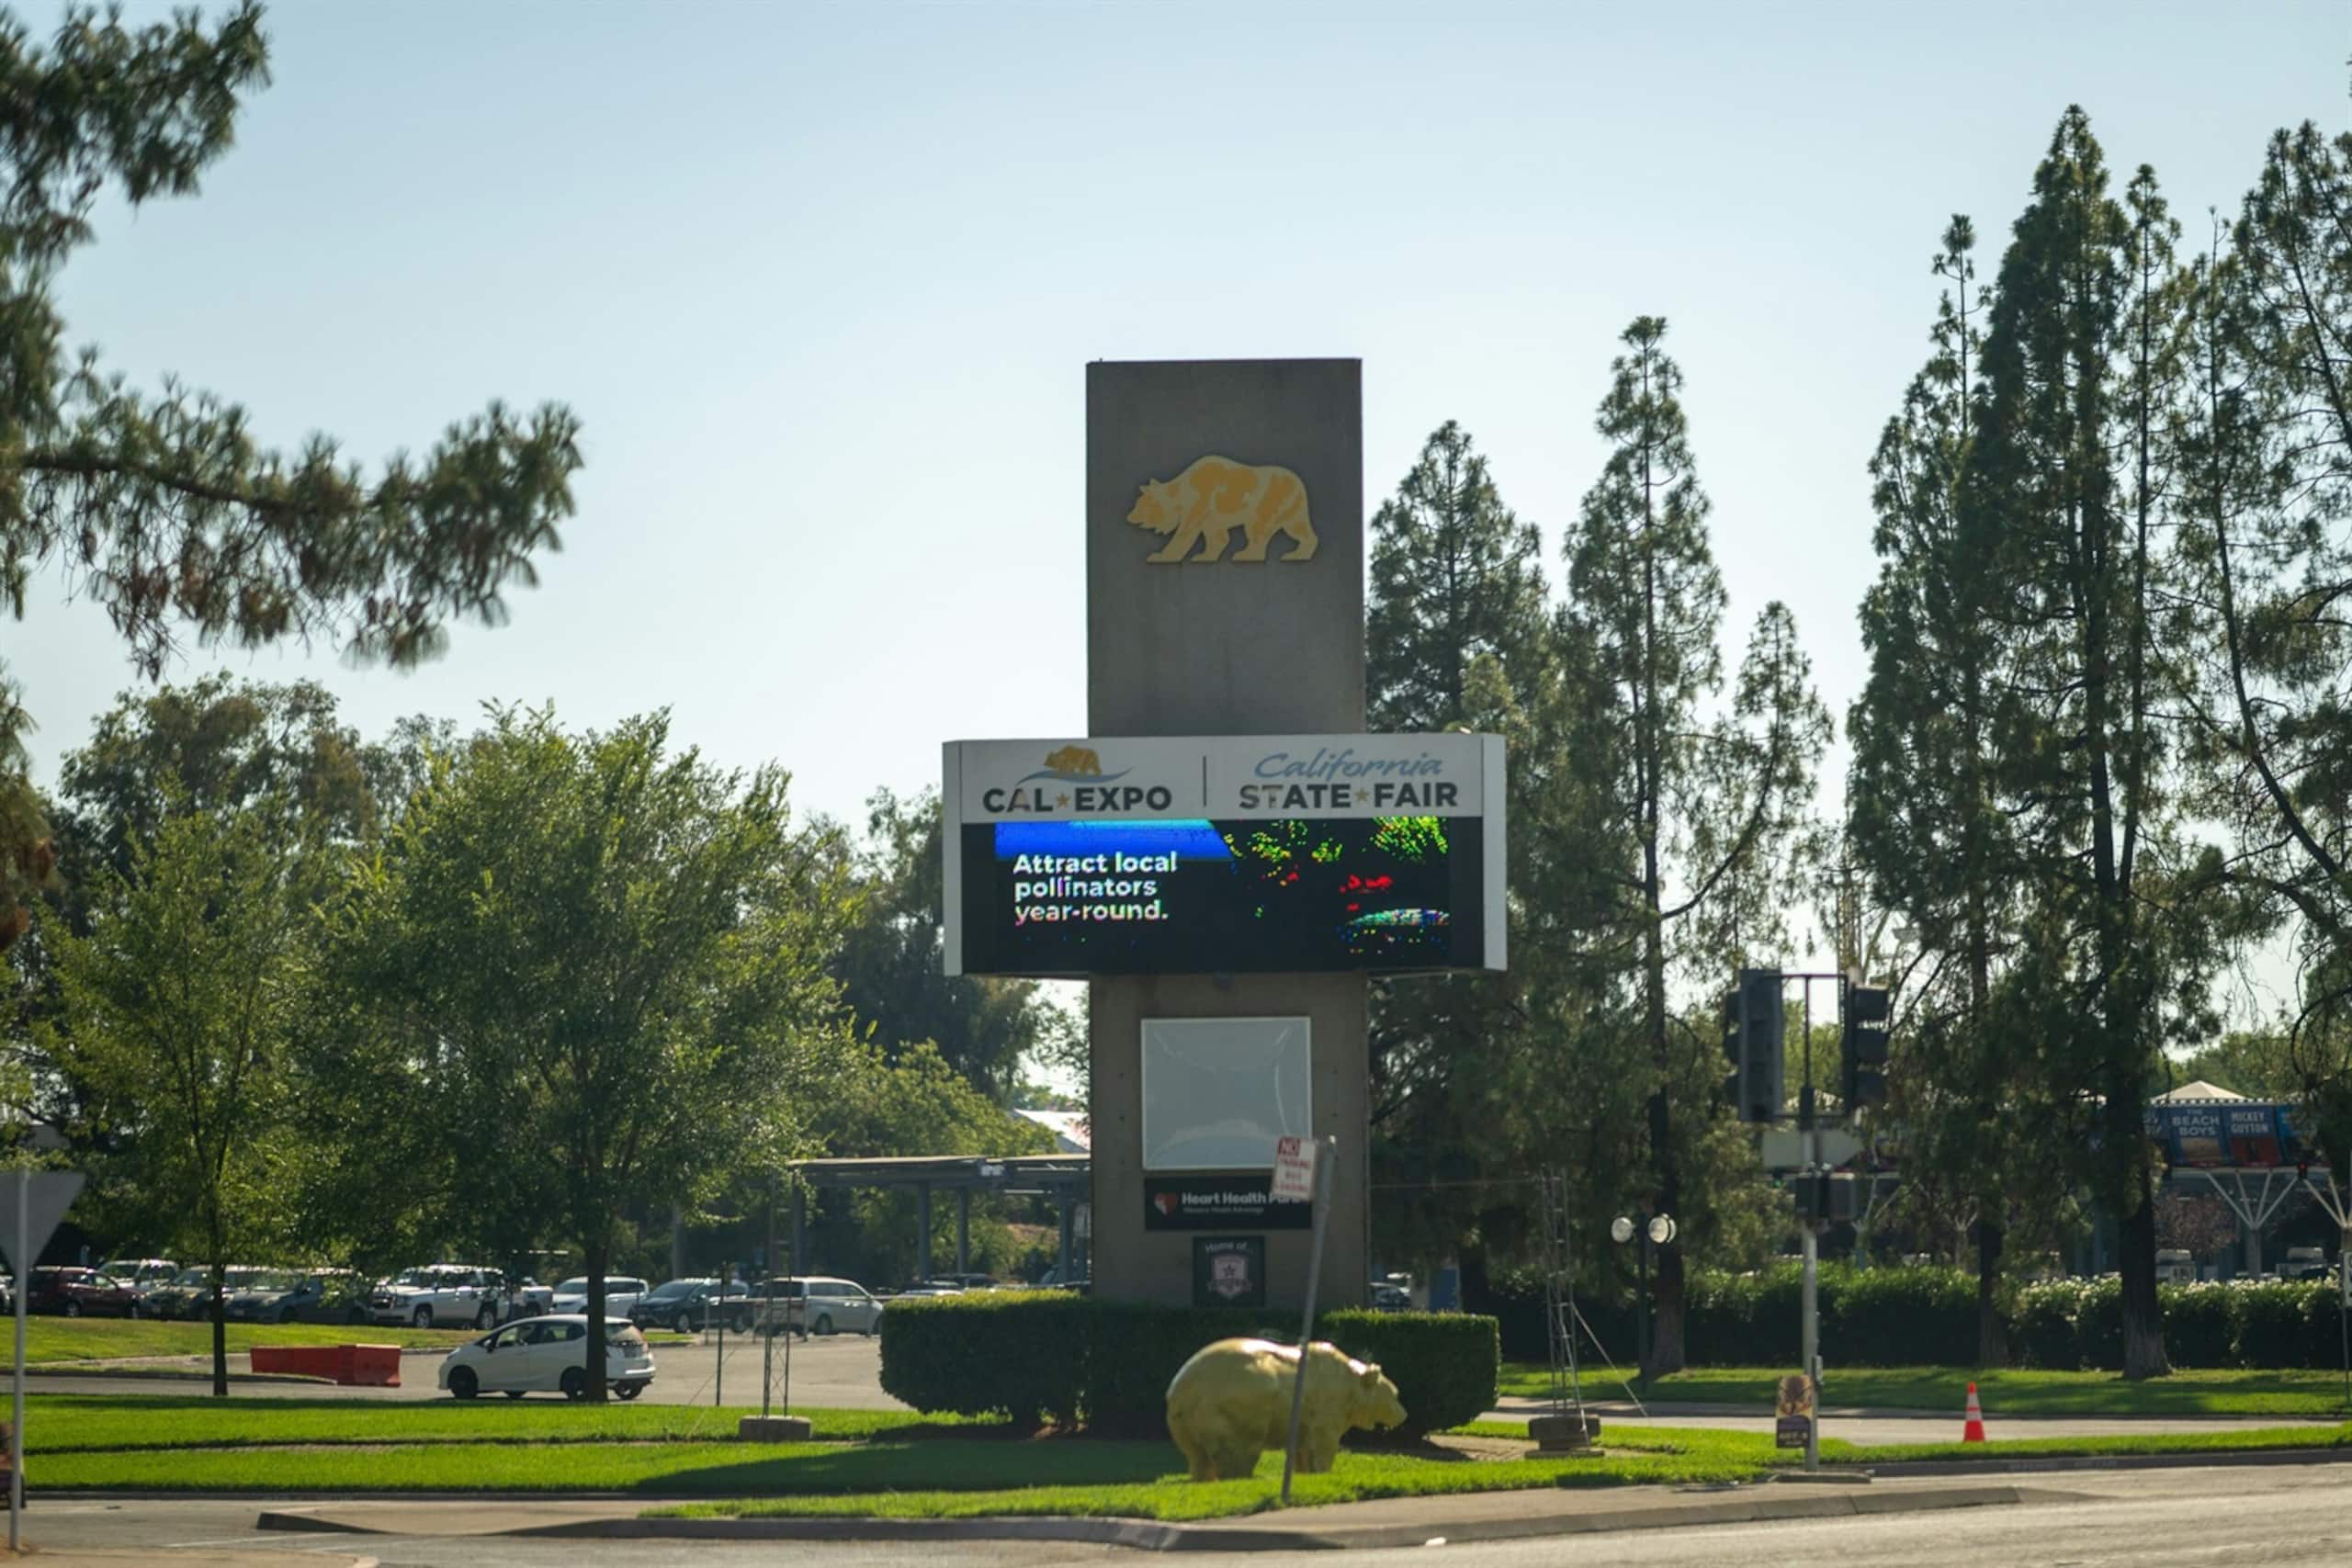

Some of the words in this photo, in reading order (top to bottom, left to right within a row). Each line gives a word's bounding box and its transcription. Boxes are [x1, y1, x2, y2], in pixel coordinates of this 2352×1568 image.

[1254, 748, 1442, 781] California
[983, 787, 1054, 813] CAL
[1075, 785, 1172, 811] EXPO
[1239, 784, 1351, 809] STATE
[1374, 783, 1458, 807] FAIR
[1013, 853, 1109, 874] Attract
[1114, 851, 1177, 873] local
[1014, 875, 1158, 903] pollinators
[1014, 899, 1169, 927] year-round.
[2172, 1116, 2220, 1126] BEACH
[2231, 1112, 2264, 1122] MICKEY
[2231, 1123, 2268, 1134] GUYTON
[2179, 1126, 2216, 1136] BOYS
[1182, 1192, 1220, 1204] Heart
[1222, 1192, 1266, 1204] Health
